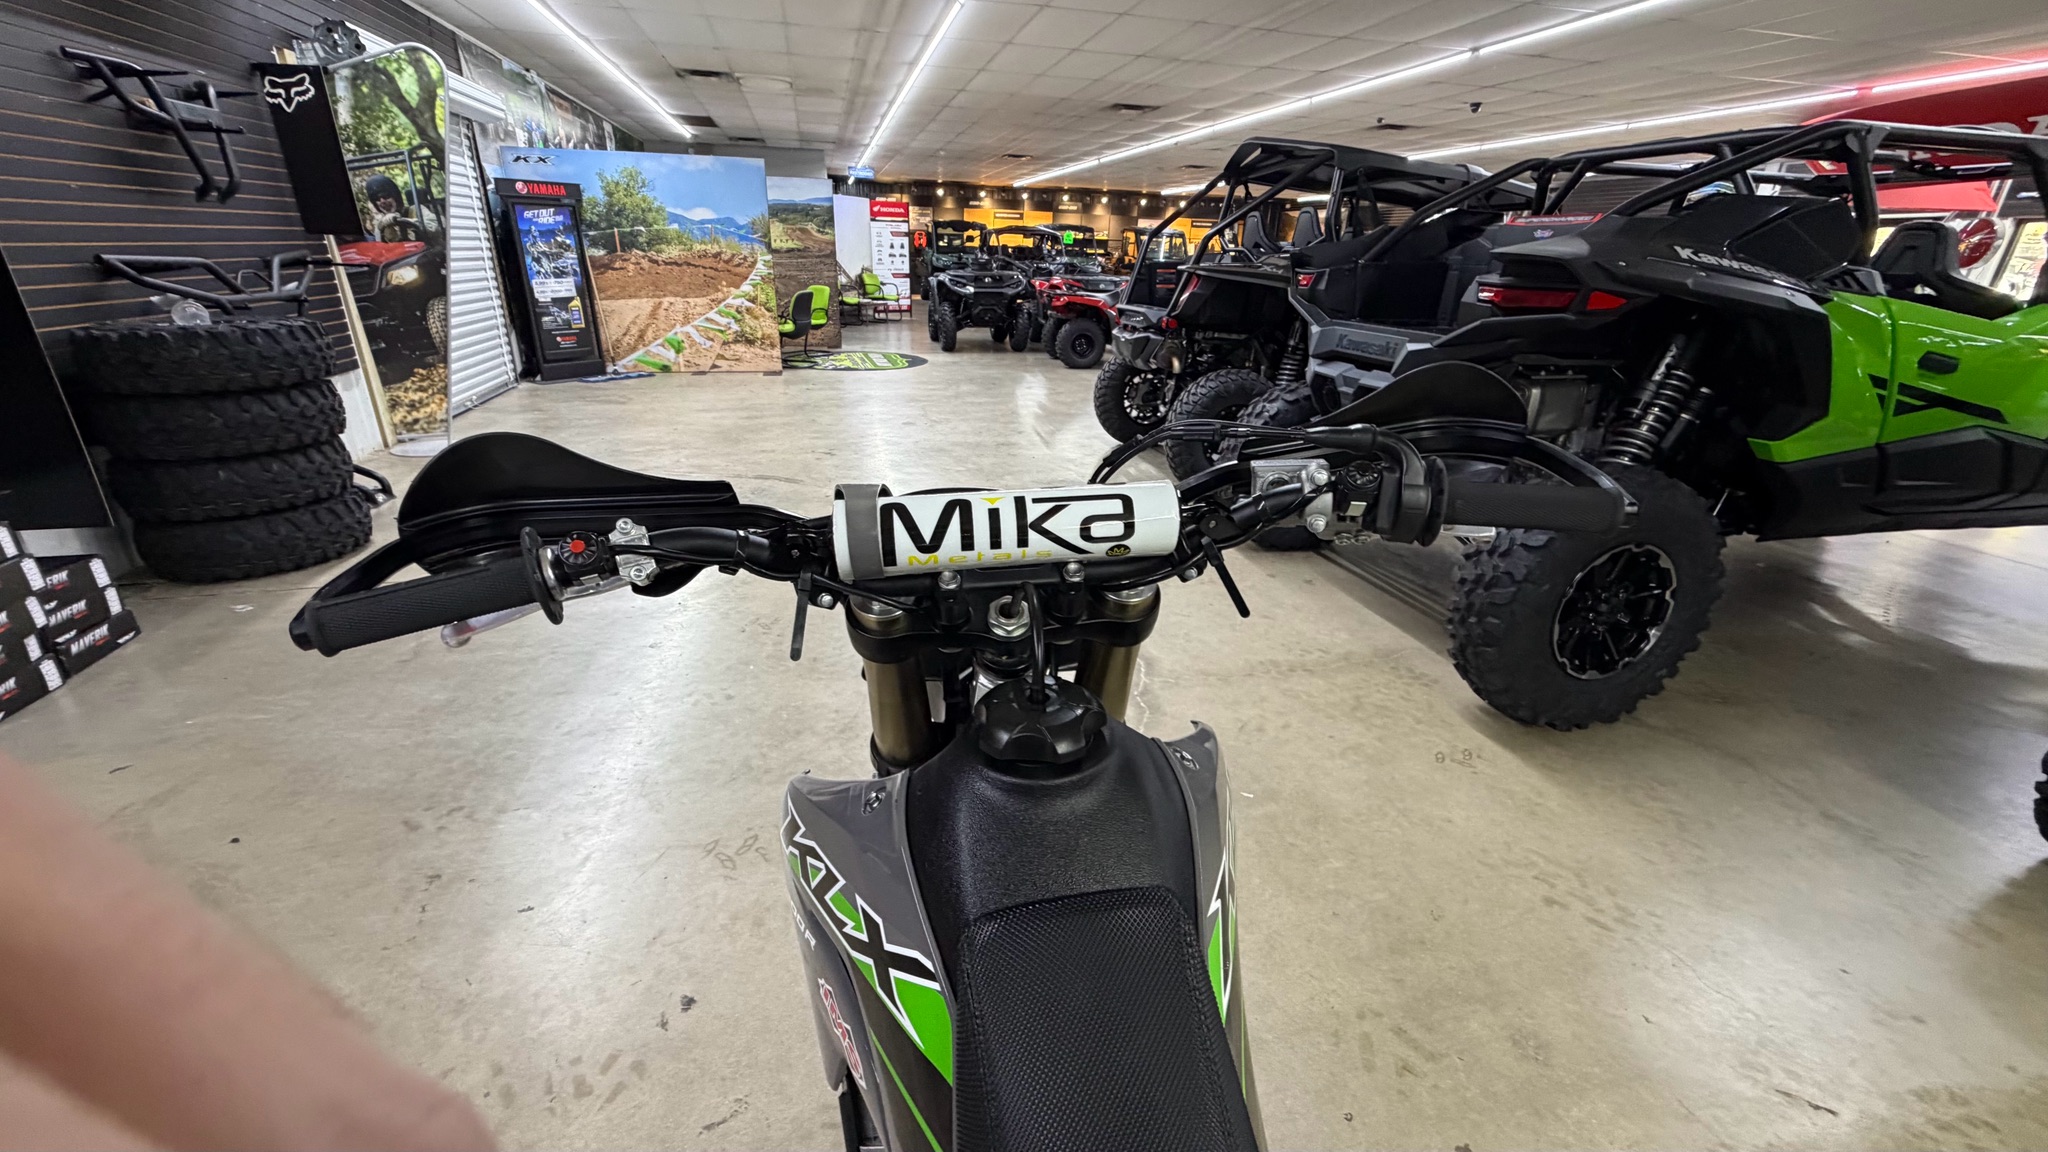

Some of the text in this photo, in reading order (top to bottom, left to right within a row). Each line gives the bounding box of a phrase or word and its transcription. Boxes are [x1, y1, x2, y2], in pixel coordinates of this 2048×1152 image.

[510, 154, 556, 165] KX
[527, 183, 567, 196] YAMAHA
[523, 210, 539, 220] GET
[539, 208, 555, 218] OUT
[880, 206, 906, 214] HONDA
[1335, 333, 1399, 354] Kawasaki
[878, 492, 1136, 568] Mika
[907, 549, 1053, 567] Metals
[48, 599, 87, 628] MAVERIK
[70, 623, 109, 656] MAVERIK
[779, 790, 943, 1051] KLX
